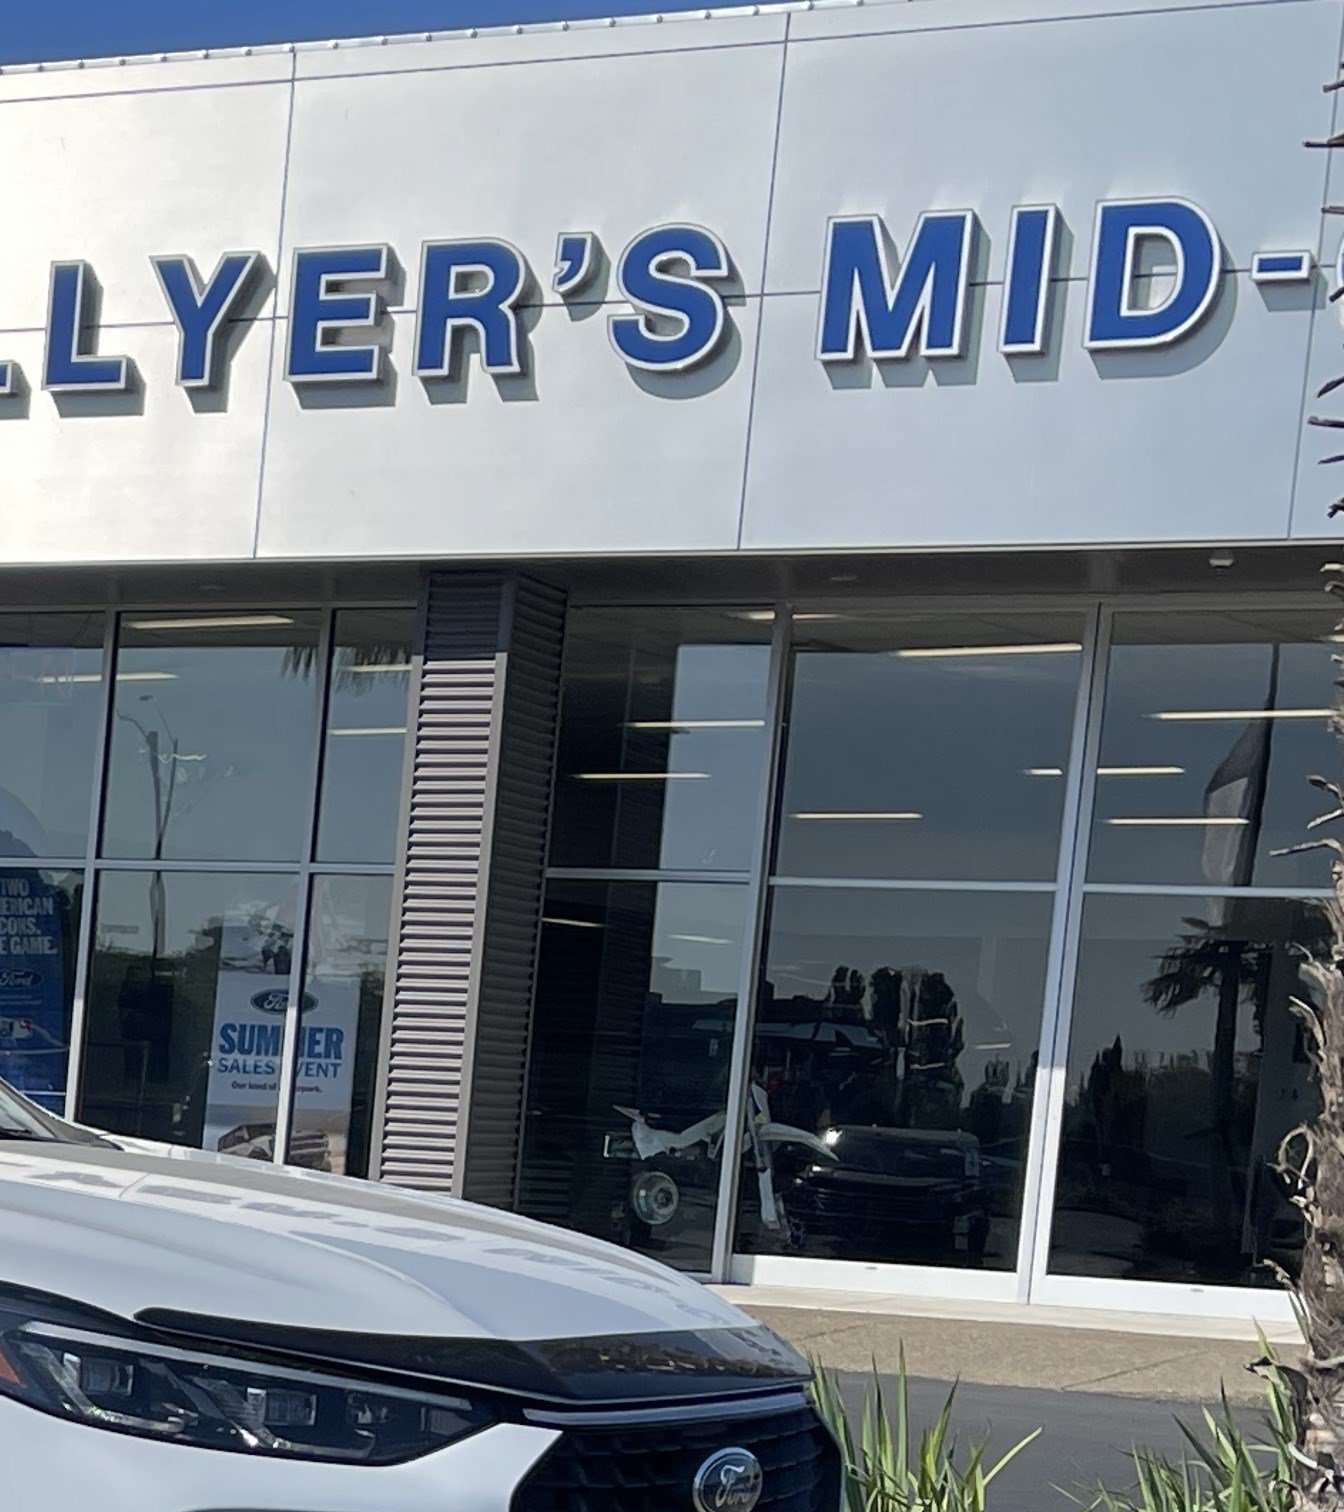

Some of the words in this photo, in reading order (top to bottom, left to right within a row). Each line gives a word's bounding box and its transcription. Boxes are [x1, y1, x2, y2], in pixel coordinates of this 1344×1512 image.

[815, 195, 1344, 363] MID-
[0, 877, 30, 897] TWO
[217, 1057, 276, 1076] SALES
